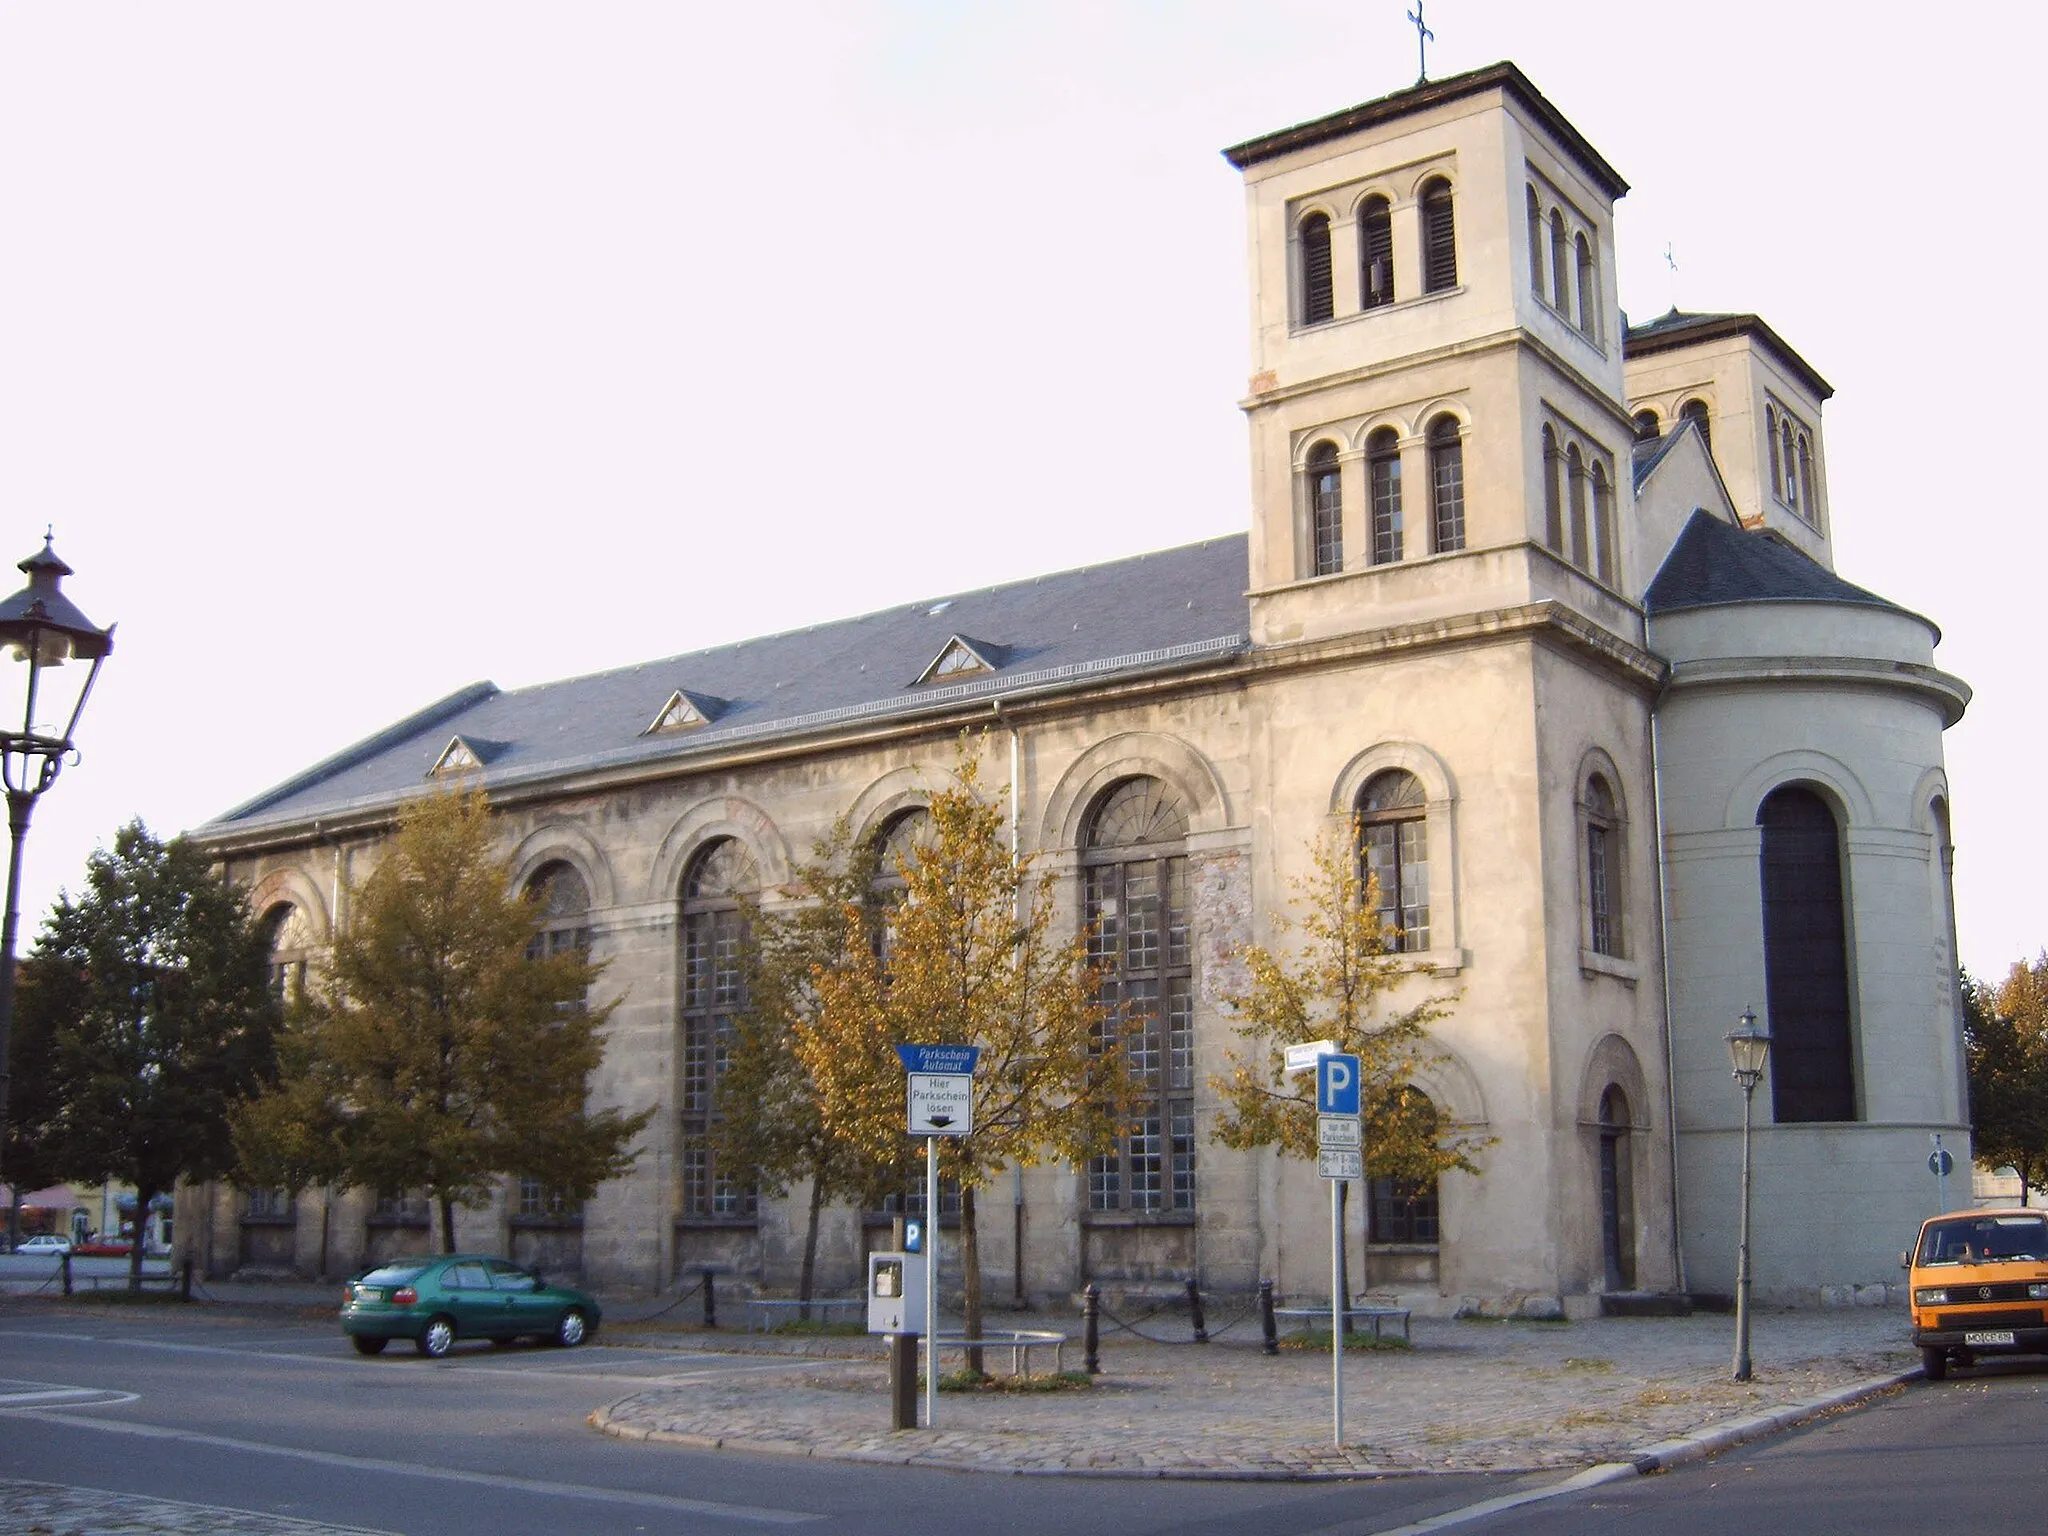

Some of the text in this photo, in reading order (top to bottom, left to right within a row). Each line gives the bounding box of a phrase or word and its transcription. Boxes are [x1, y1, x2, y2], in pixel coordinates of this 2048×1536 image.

[919, 1047, 970, 1060] Parkschein
[923, 1060, 962, 1071] Automat
[929, 1078, 950, 1089] Hier
[1327, 1061, 1350, 1106] P
[912, 1090, 968, 1101] Parkschein
[1322, 1131, 1356, 1142] Parkschein
[907, 1224, 919, 1246] P
